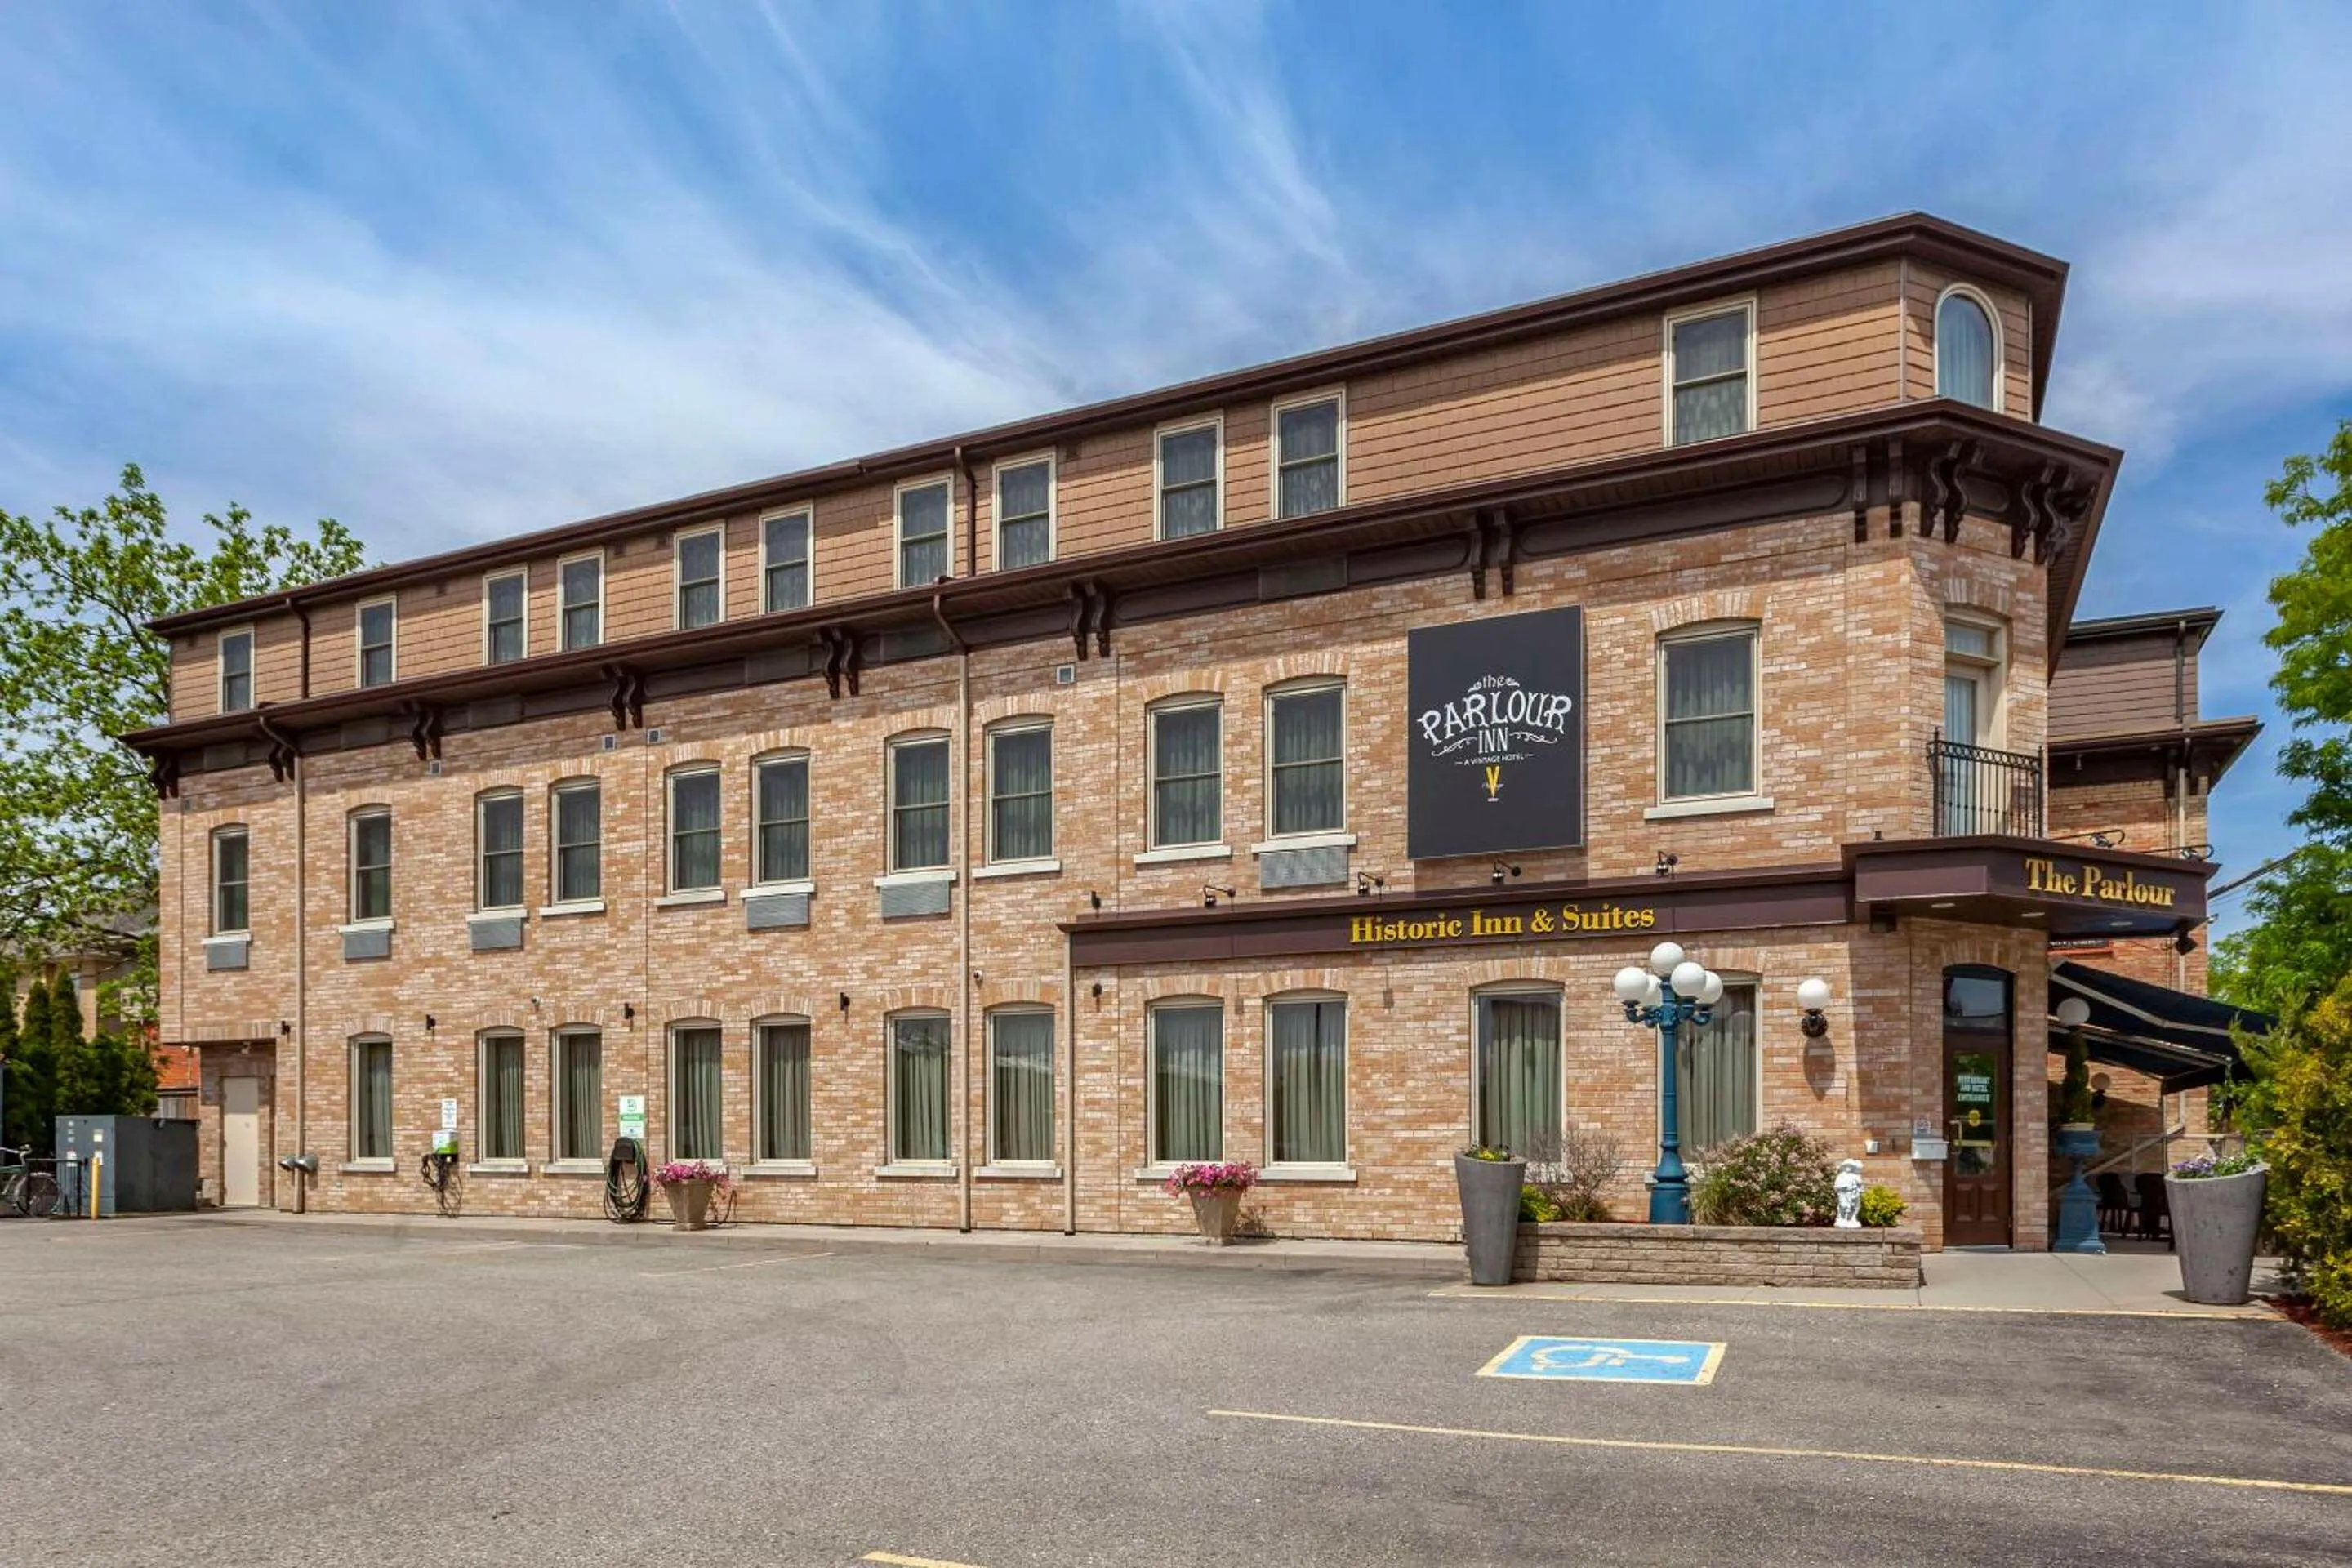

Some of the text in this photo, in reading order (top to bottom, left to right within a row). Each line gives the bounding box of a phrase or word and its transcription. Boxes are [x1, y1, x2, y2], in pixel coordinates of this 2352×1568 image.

[1417, 690, 1572, 745] PARLOUR
[1478, 727, 1509, 754] INN
[1502, 753, 1524, 763] HOTEL
[2025, 858, 2176, 906] The Parlour
[1349, 903, 1655, 943] Historic Inn & Suites
